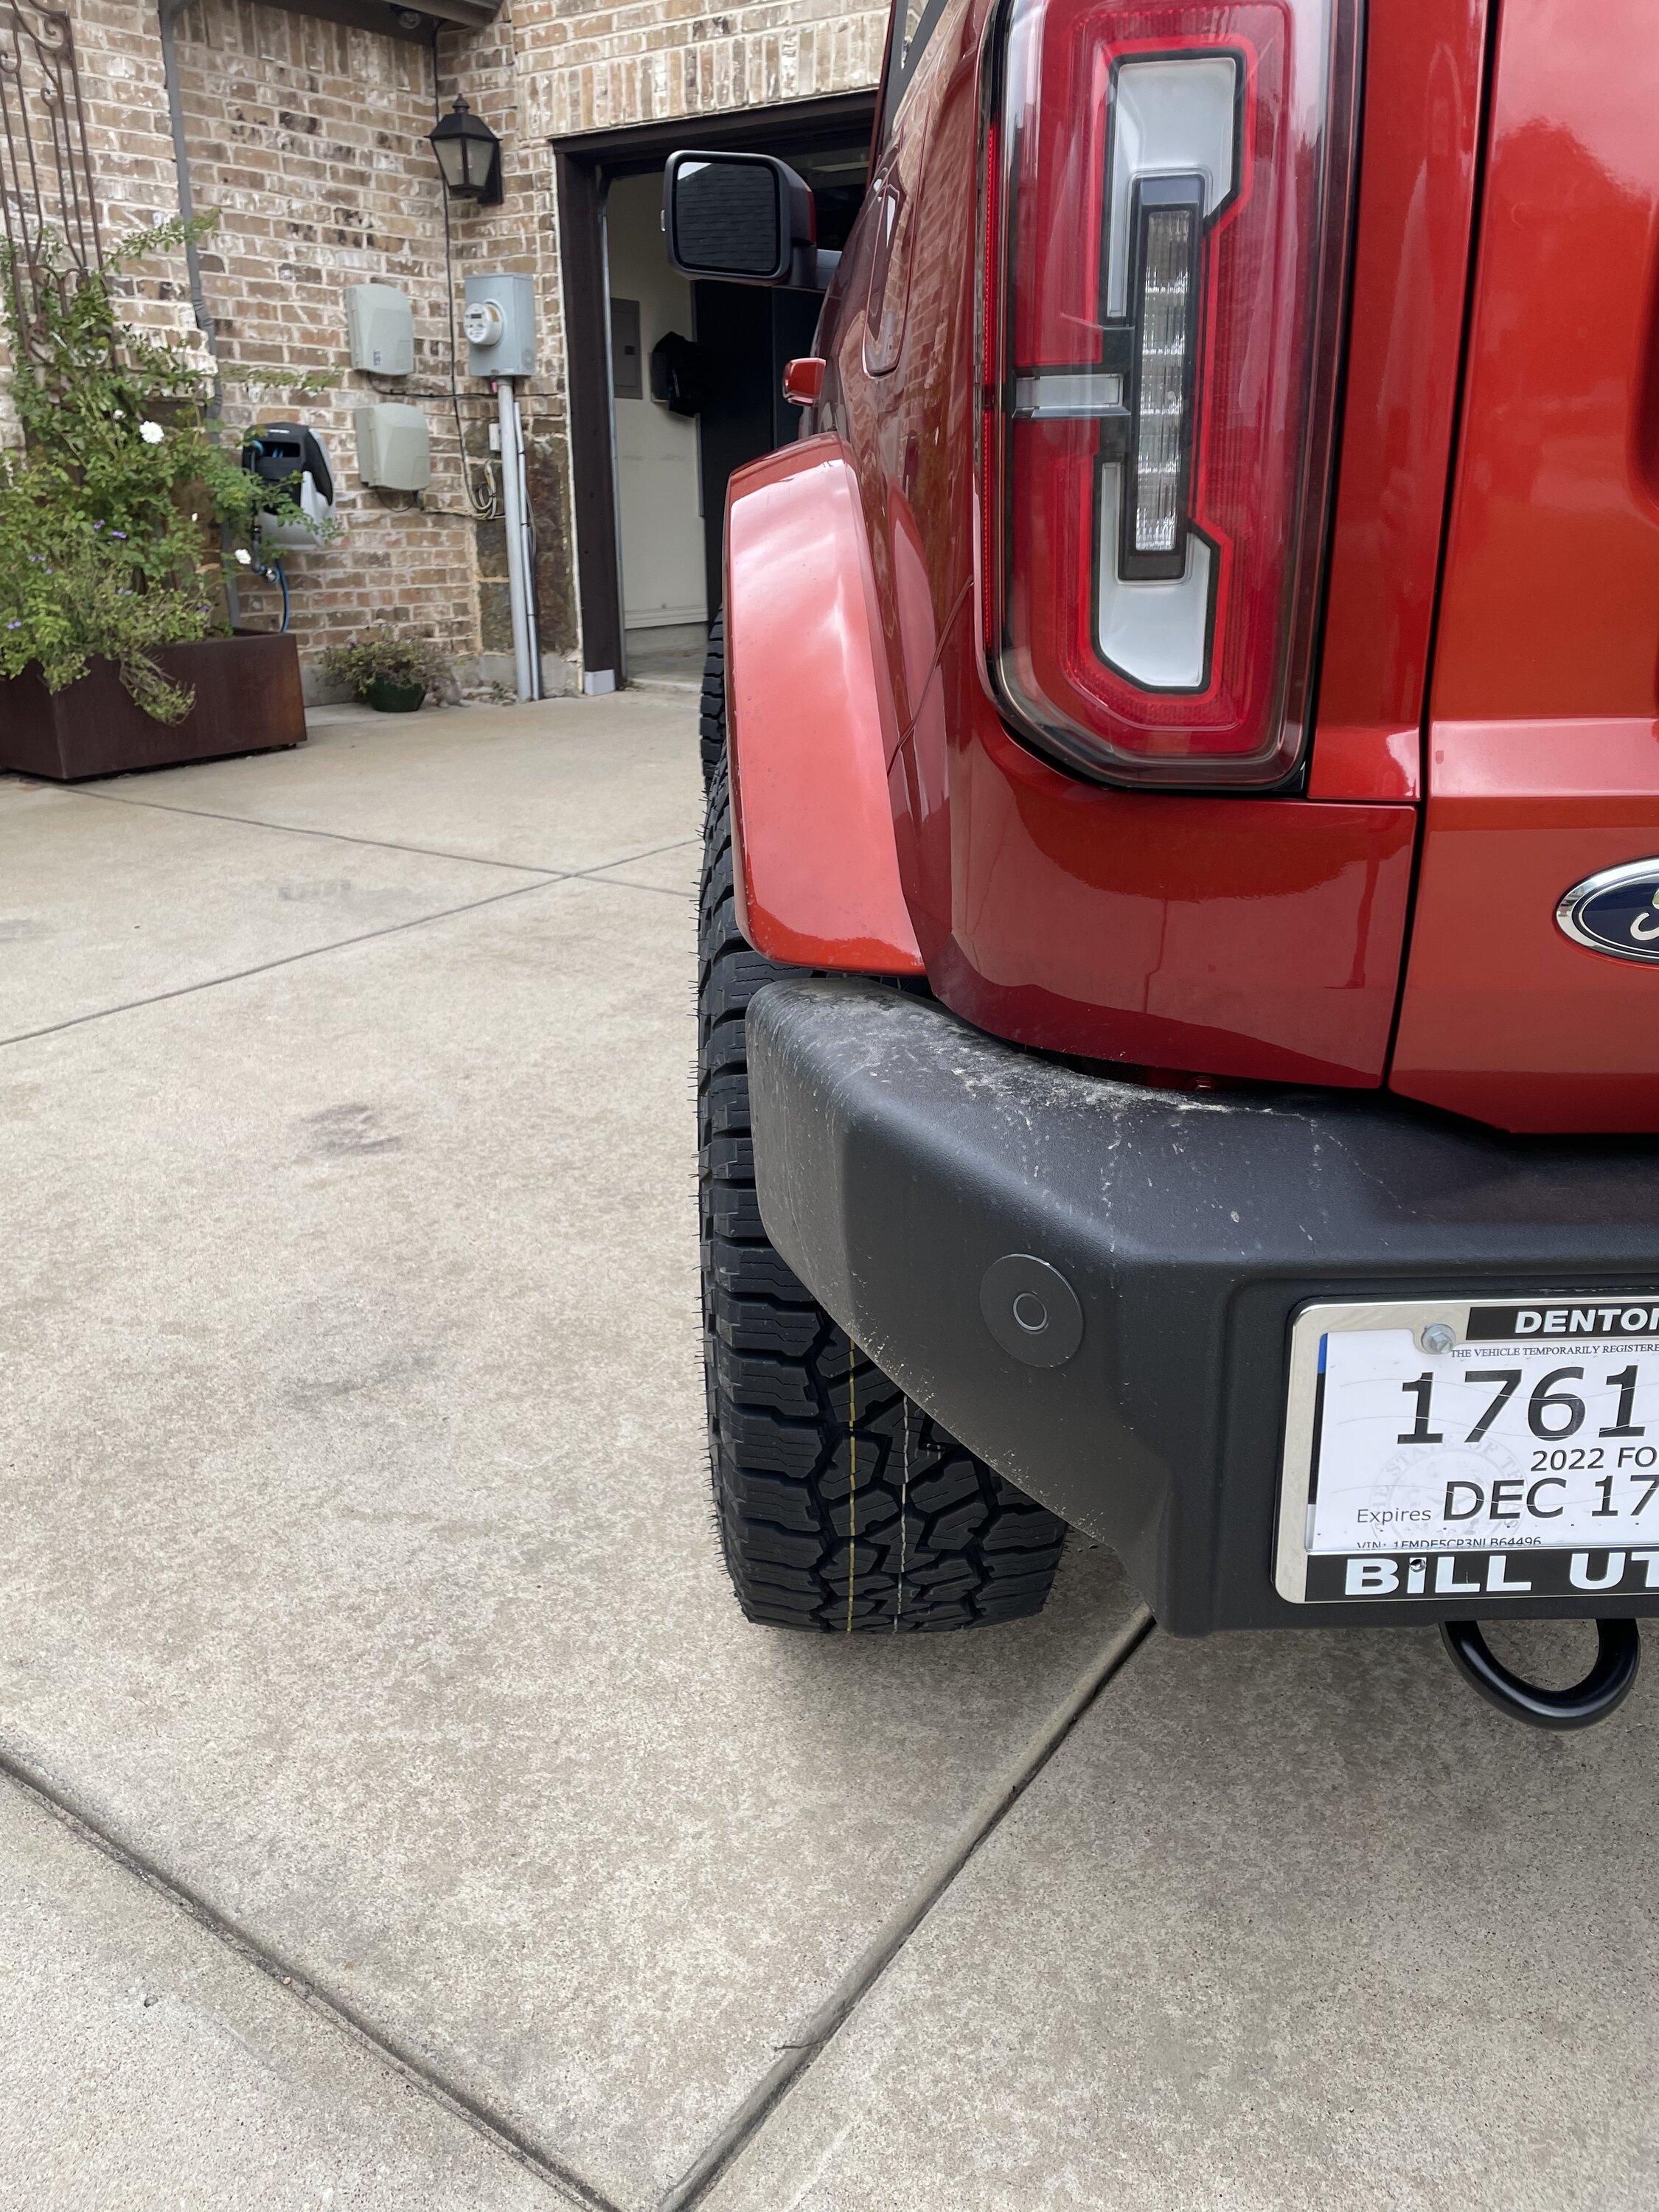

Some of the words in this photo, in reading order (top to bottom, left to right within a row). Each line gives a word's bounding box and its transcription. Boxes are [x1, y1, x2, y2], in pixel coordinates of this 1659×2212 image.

[1451, 1349, 1472, 1357] THE
[1474, 1348, 1520, 1357] VEHICLE
[1523, 1346, 1600, 1356] TEMPORARILY
[1397, 1365, 1646, 1444] 1761
[1531, 1447, 1604, 1472] 2022
[1618, 1446, 1658, 1468] FO
[1357, 1508, 1431, 1525] Expires
[1444, 1478, 1567, 1521] DEC
[1592, 1475, 1659, 1517] 17
[1345, 1555, 1532, 1595] BILL
